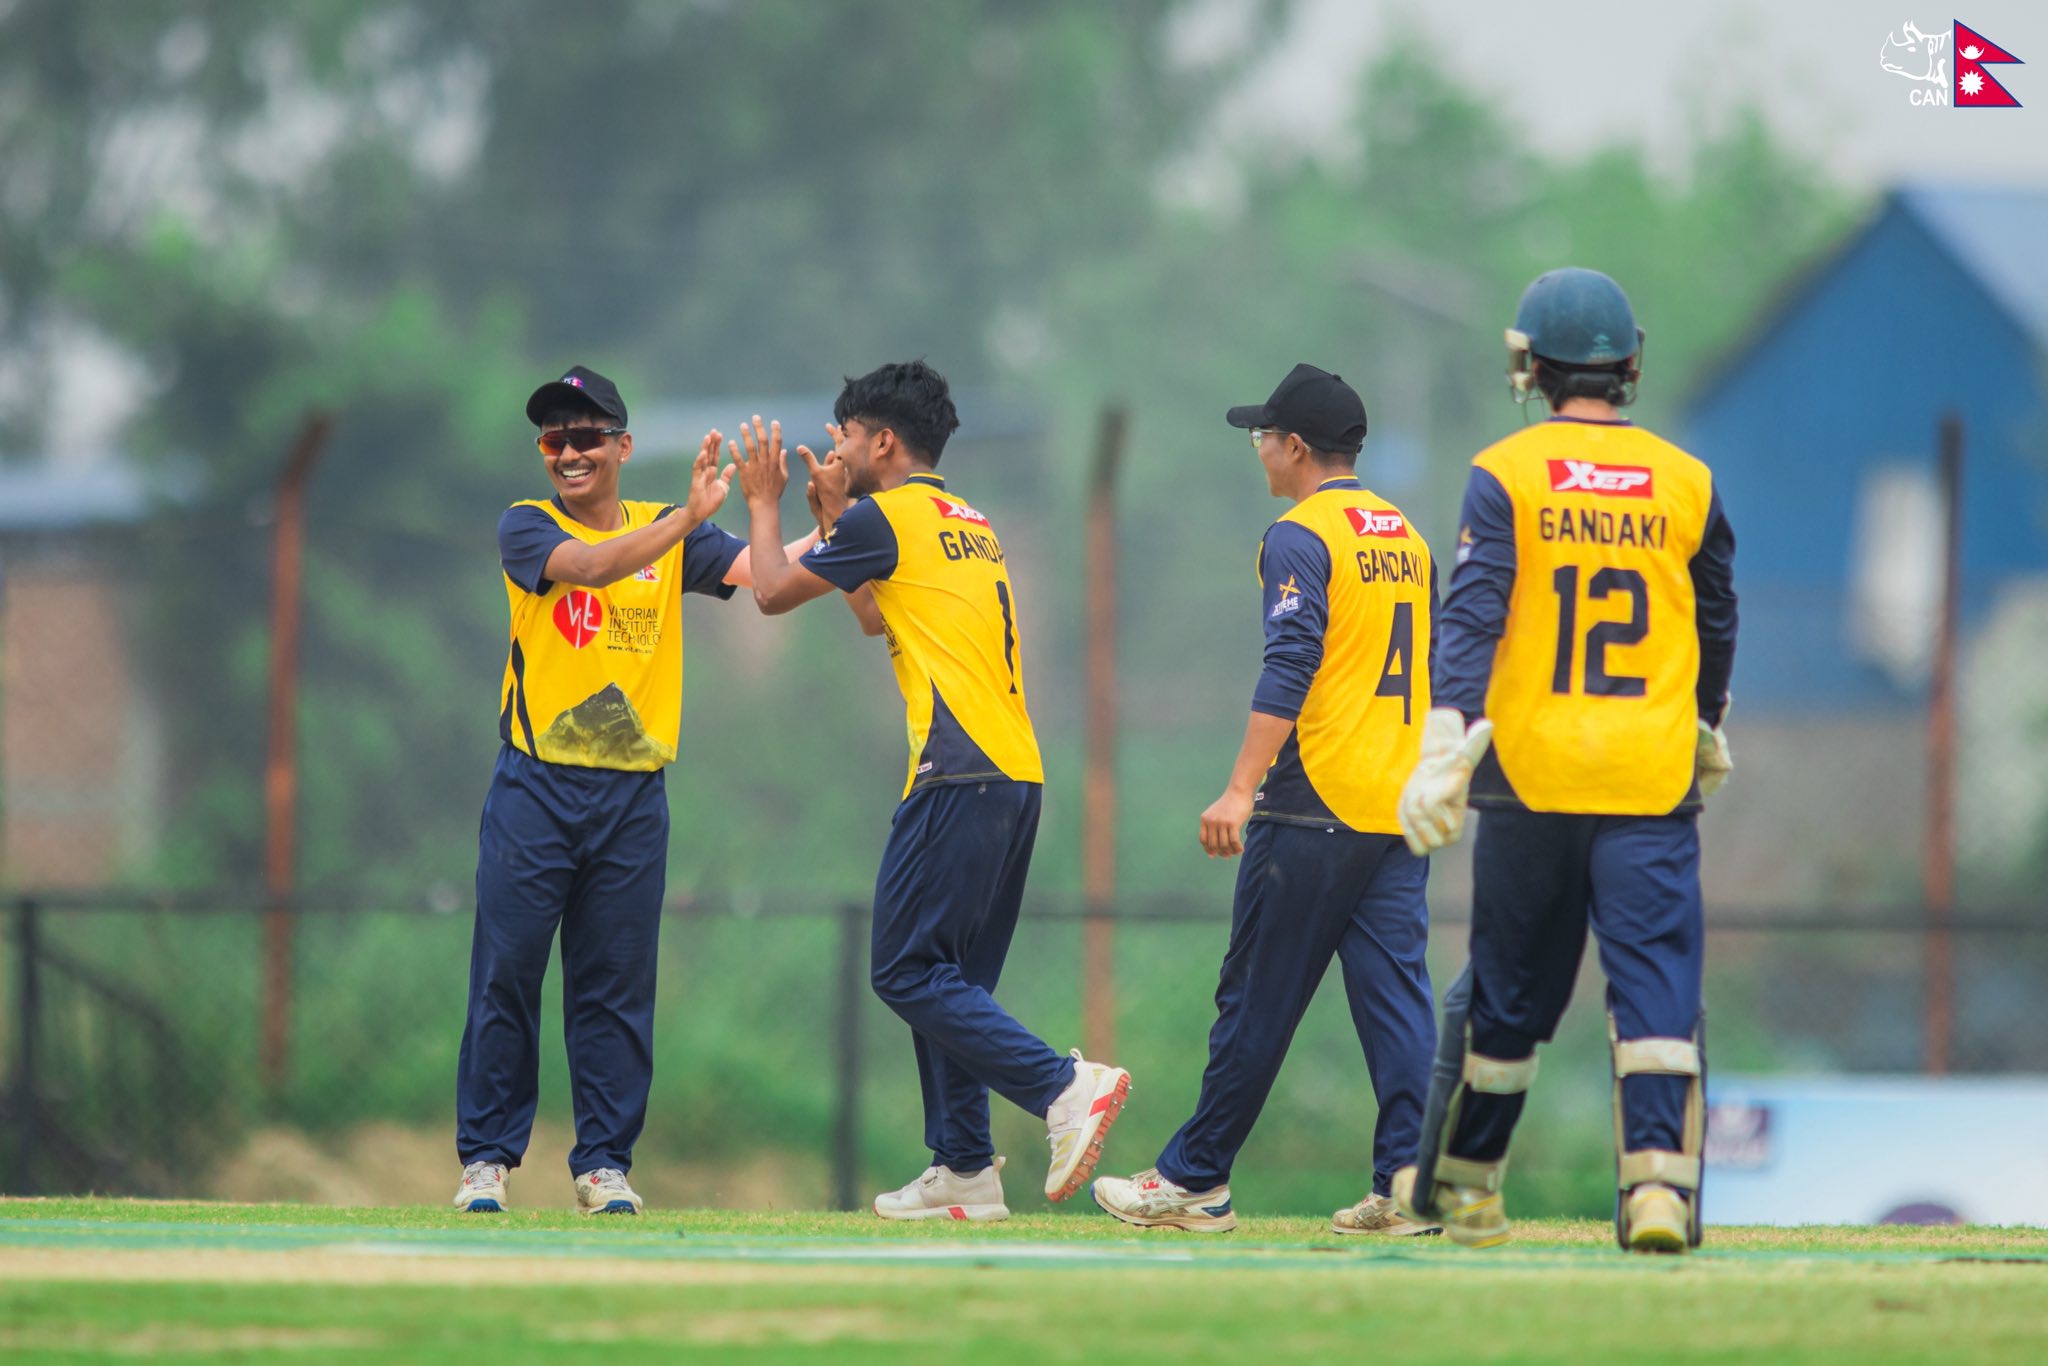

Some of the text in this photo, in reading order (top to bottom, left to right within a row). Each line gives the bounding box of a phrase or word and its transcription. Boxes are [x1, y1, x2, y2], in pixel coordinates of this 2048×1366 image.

[1539, 507, 1668, 551] GANDAKI
[1356, 548, 1424, 588] GANDAKI
[607, 603, 659, 620] VITORIAN
[609, 617, 661, 633] INSITUTE
[1551, 564, 1650, 697] 12
[996, 580, 1019, 694] 1
[1375, 602, 1414, 726] 4
